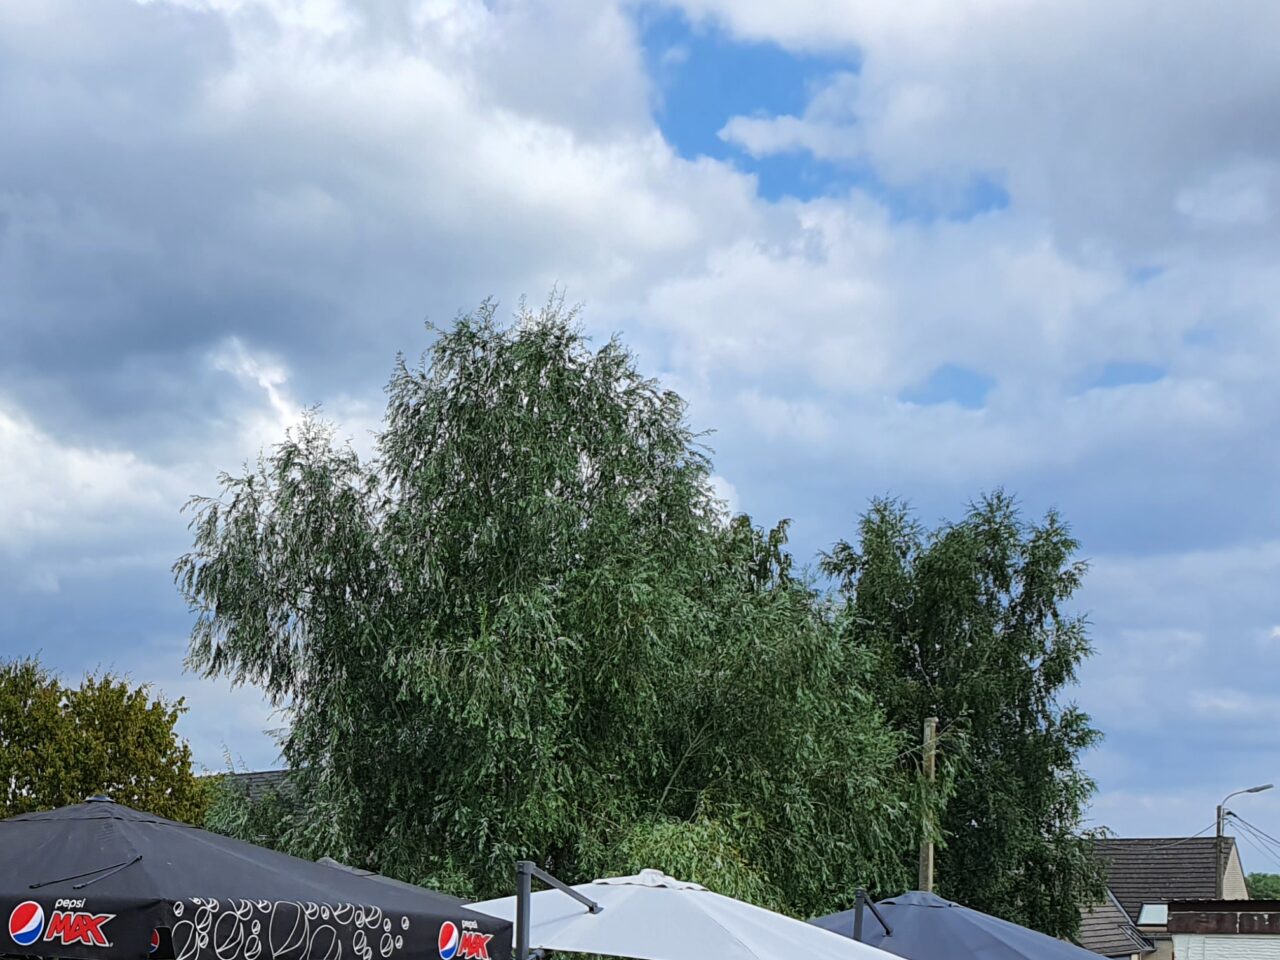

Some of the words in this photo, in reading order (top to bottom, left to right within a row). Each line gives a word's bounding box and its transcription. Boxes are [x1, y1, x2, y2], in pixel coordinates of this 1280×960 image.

[55, 898, 86, 909] pepsi
[43, 911, 116, 947] MAX
[456, 931, 494, 960] MAX
